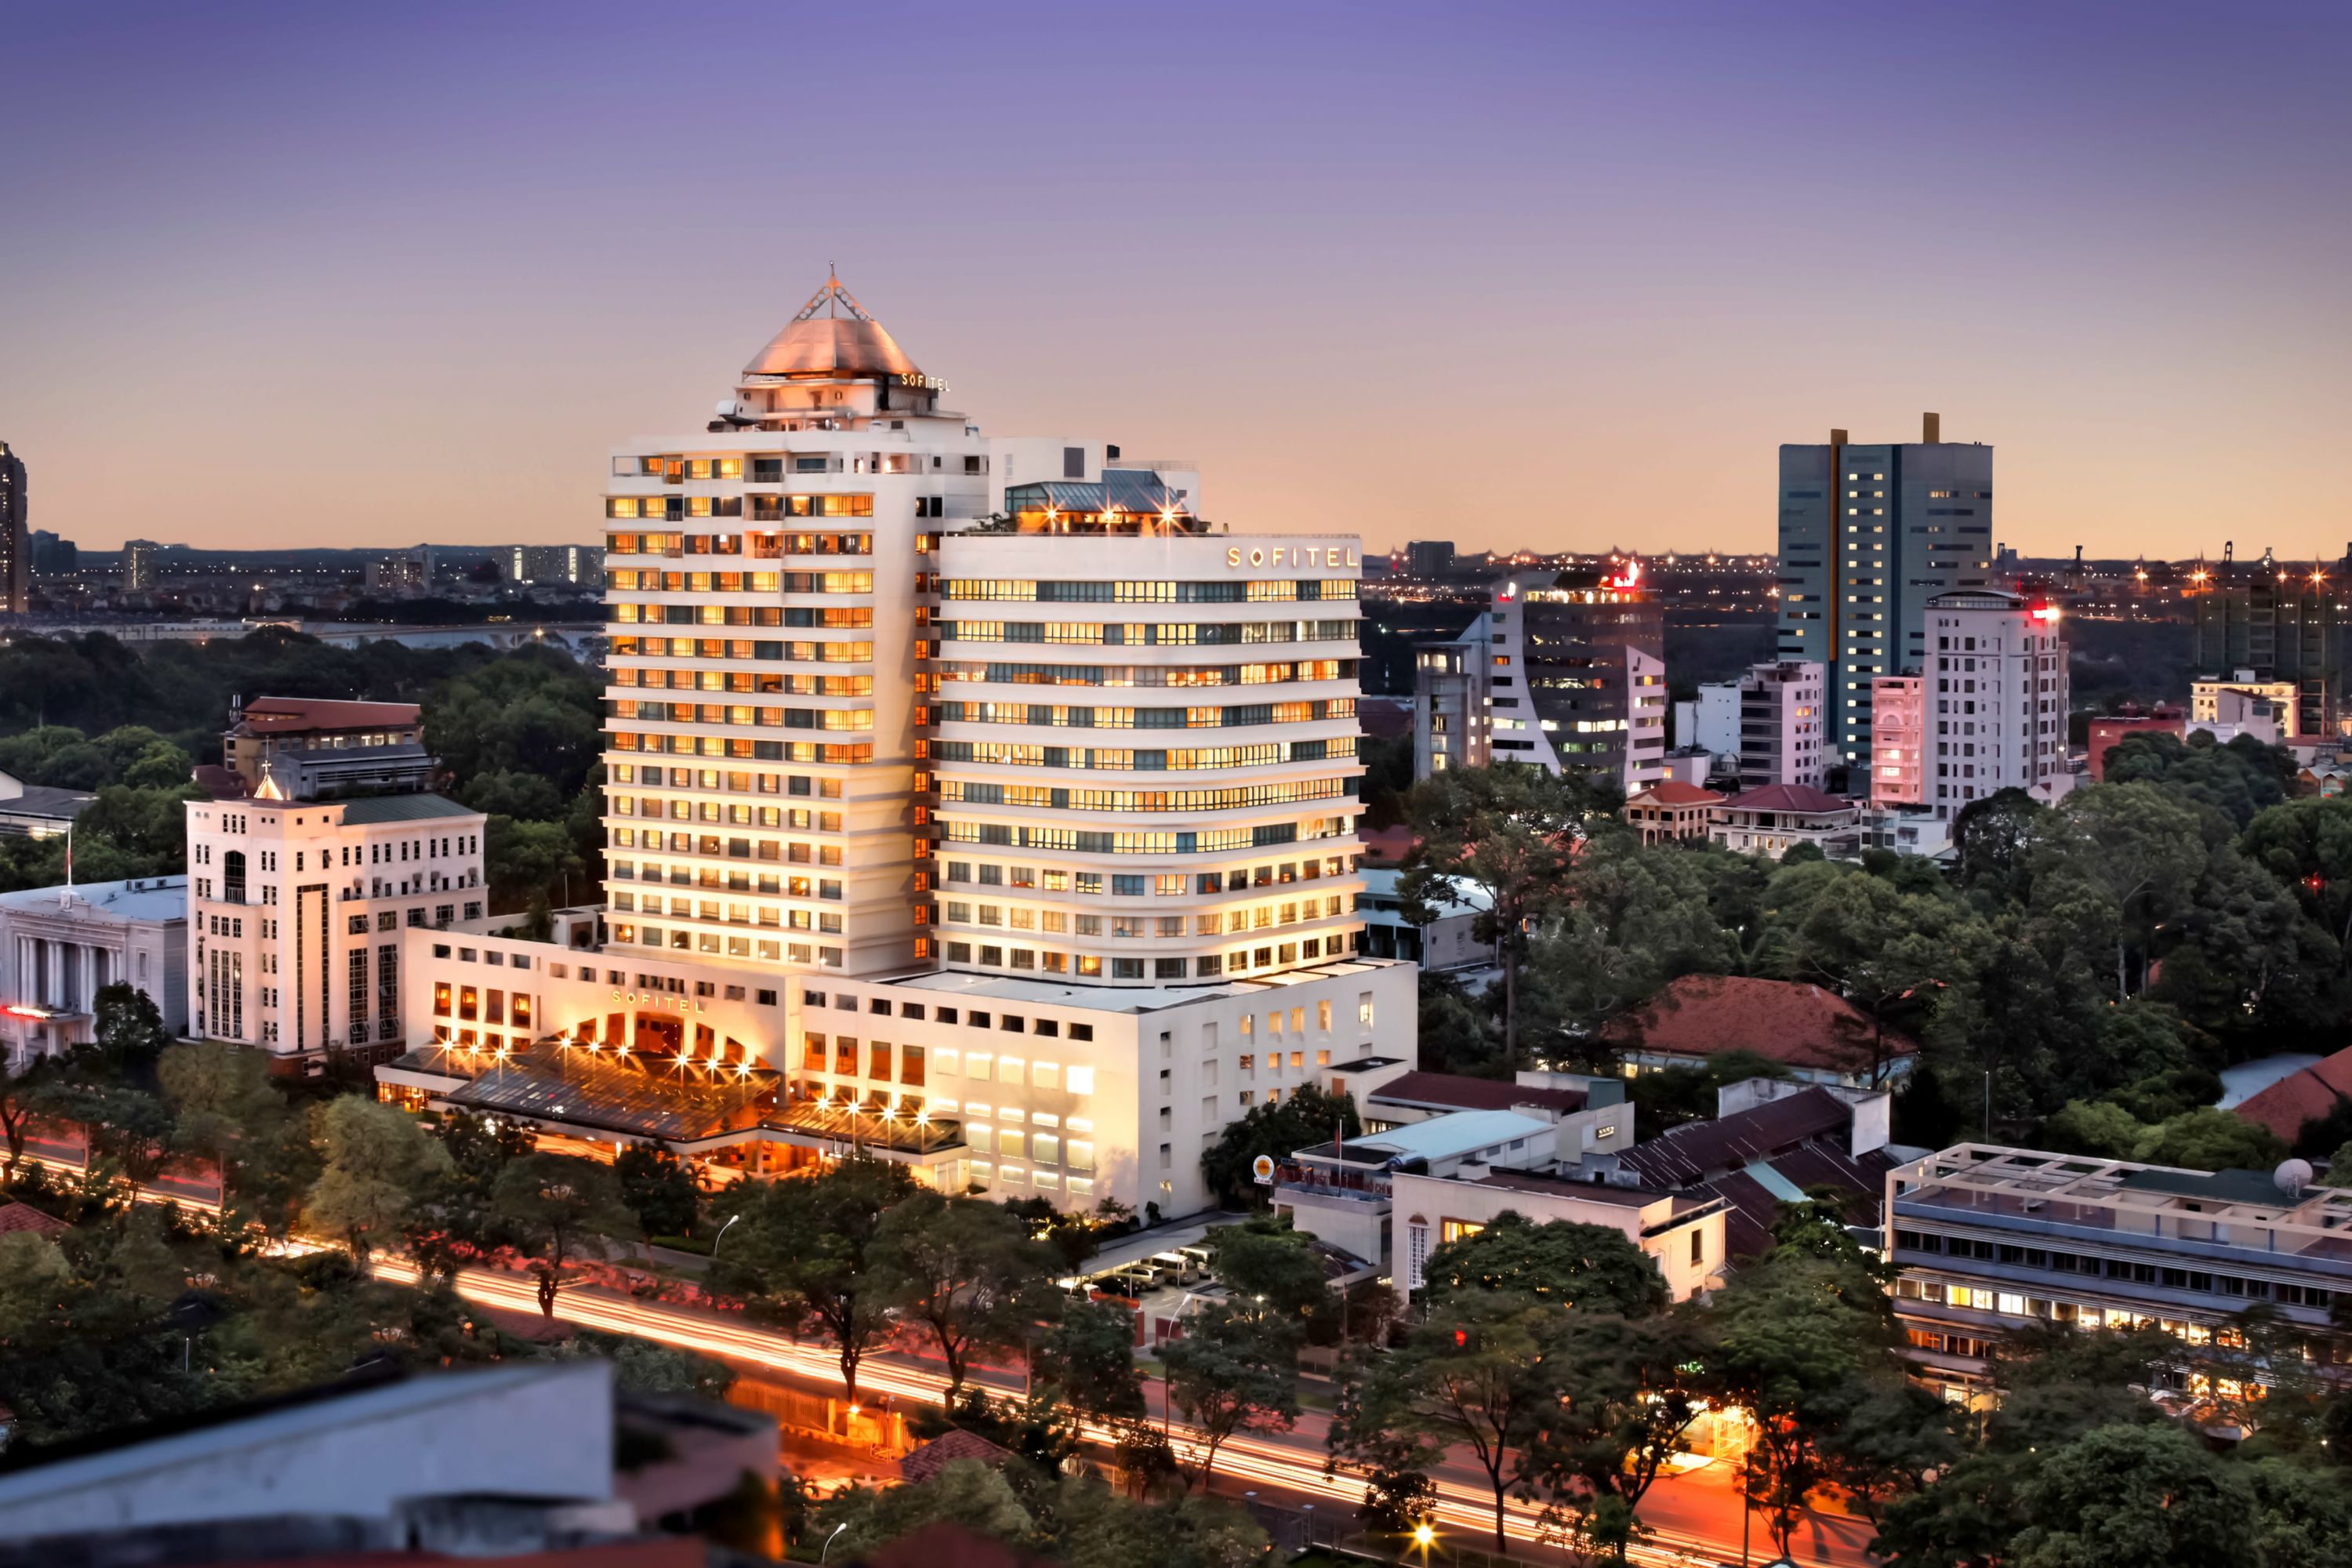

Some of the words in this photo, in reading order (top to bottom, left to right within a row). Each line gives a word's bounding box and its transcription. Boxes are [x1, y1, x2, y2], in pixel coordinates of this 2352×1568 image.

[902, 372, 950, 392] SOFITEL
[1228, 547, 1359, 567] SOFITEL
[612, 991, 704, 1014] SOFITEL
